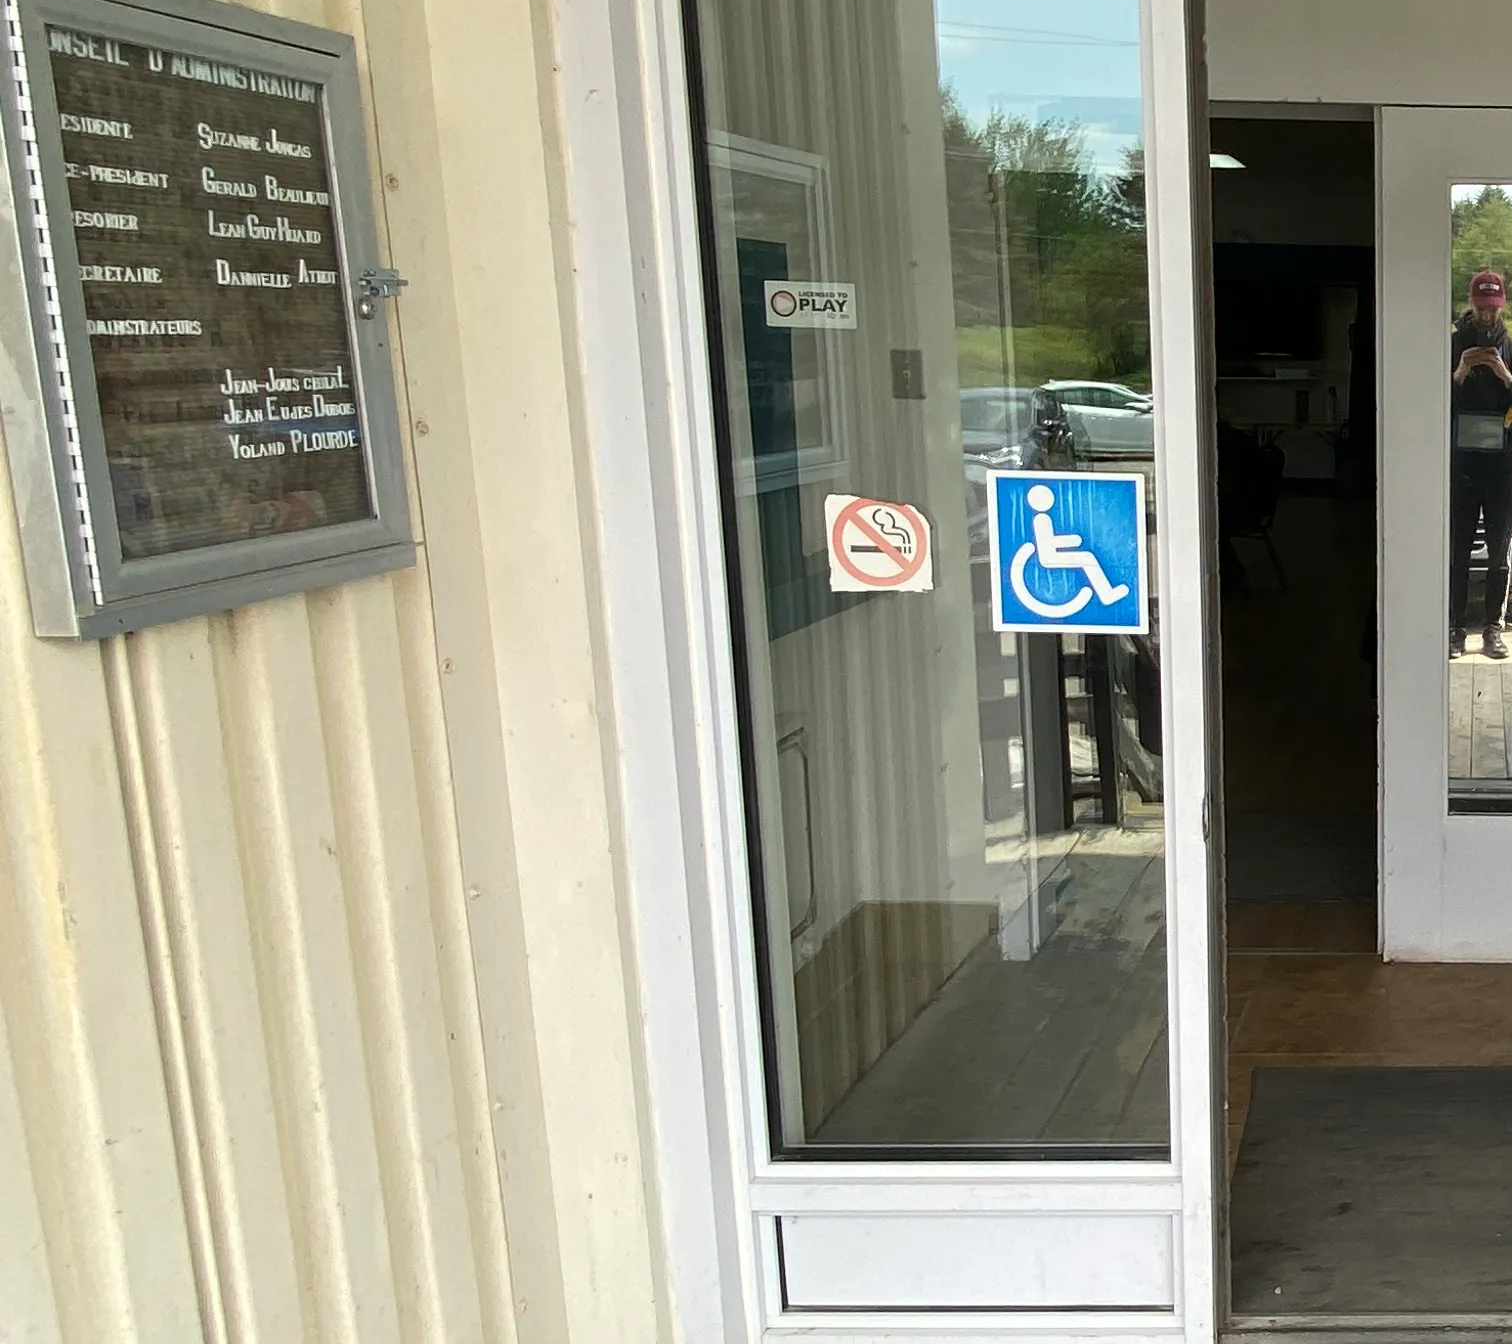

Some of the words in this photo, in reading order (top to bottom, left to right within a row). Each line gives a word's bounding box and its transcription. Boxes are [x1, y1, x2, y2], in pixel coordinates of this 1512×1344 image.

[799, 298, 848, 312] PLAY
[223, 398, 264, 425] JEAN
[228, 433, 286, 460] YOLAND
[290, 429, 359, 454] PLOURDE
